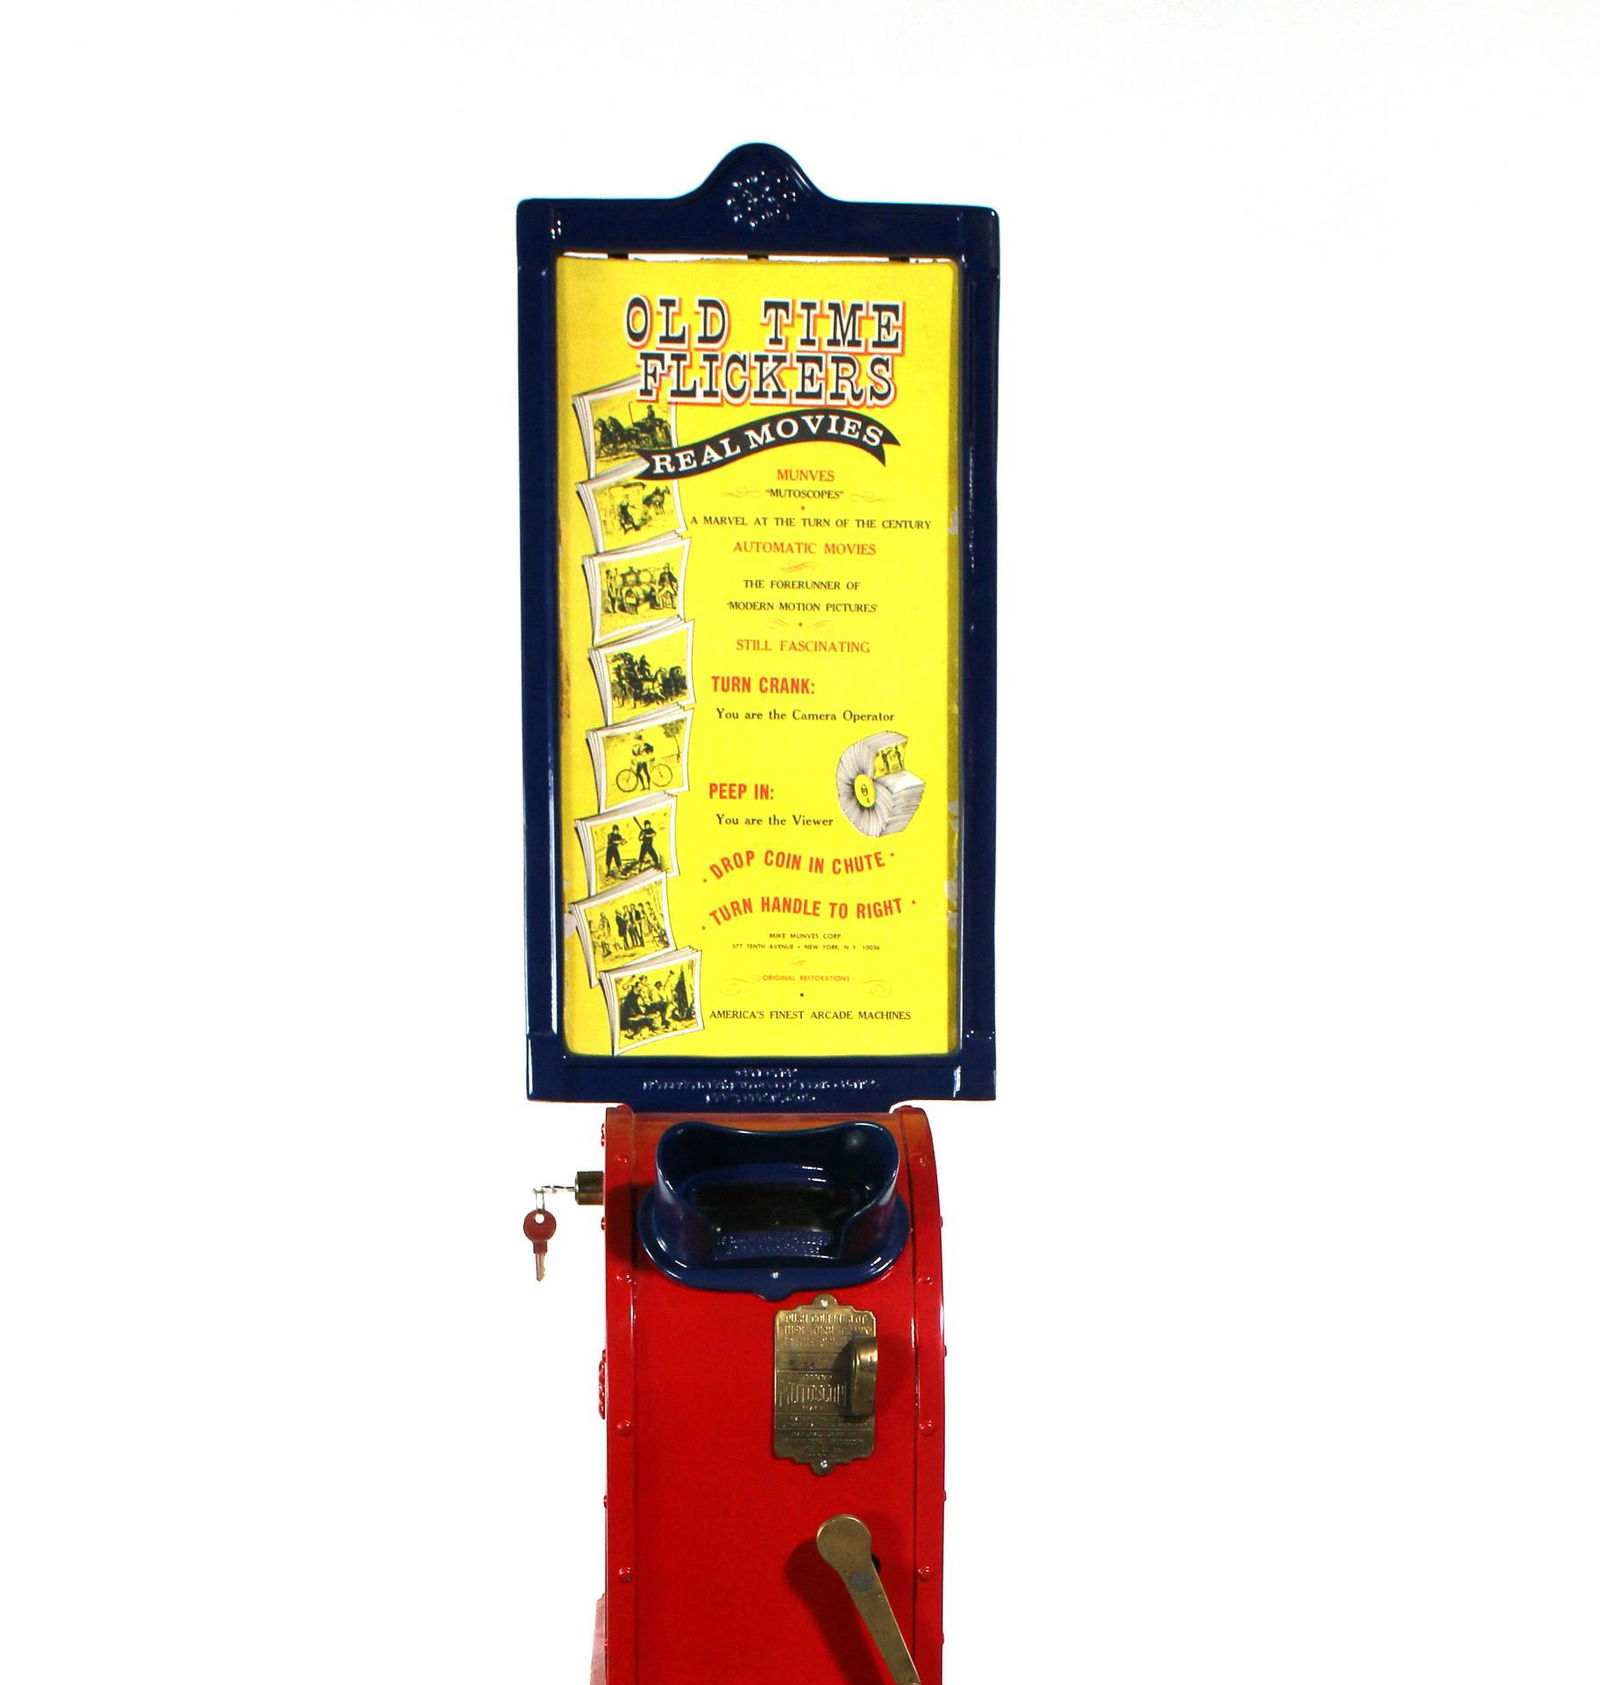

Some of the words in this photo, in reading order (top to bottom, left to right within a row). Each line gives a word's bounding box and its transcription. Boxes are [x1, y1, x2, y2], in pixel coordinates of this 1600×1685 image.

[625, 294, 730, 350] OLD
[761, 298, 904, 354] TIME
[637, 352, 898, 407] FLICKERS
[652, 437, 741, 474] REAL
[749, 414, 885, 449] MOVIES
[776, 468, 835, 483] MUNVES
[690, 515, 699, 525] A
[703, 515, 748, 526] MARVEL
[753, 516, 769, 527] AT
[774, 516, 796, 527] THE
[801, 517, 831, 528] TURN
[834, 518, 850, 528] OF
[854, 518, 877, 529] THE
[881, 519, 932, 530] CENTURY
[733, 540, 817, 555] AUTOMATIC
[824, 542, 877, 556] MOVIES
[743, 579, 765, 589] THE
[770, 579, 841, 591] FORERUNNER
[845, 581, 861, 591] OF
[779, 601, 821, 612] MOTION
[735, 638, 773, 652] STILL
[779, 639, 871, 654] FASCINATING
[710, 675, 752, 693] TURN
[758, 676, 815, 695] CRANK:
[715, 707, 740, 720] You
[744, 712, 764, 720] are
[768, 708, 787, 721] the
[791, 708, 837, 721] Camera
[842, 709, 895, 724] Operator
[708, 782, 748, 800] PEEP
[754, 783, 774, 801] IN:
[715, 813, 739, 826] You
[744, 817, 763, 826] are
[768, 813, 787, 826] the
[791, 814, 834, 827] Viewer
[708, 849, 756, 880] DROP
[763, 849, 802, 871] COIN
[808, 856, 825, 874] IN
[831, 850, 886, 876] CHUTE
[708, 897, 754, 926] TURN
[760, 895, 822, 917] HANDLE
[828, 901, 849, 920] TO
[856, 897, 902, 920] RIGHT
[789, 932, 820, 940] MUNVES
[761, 974, 796, 982] ORIGINAL
[799, 974, 851, 982] RESTORATIONS
[709, 1009, 765, 1020] AMERICA'S
[769, 1010, 805, 1020] FINEST
[810, 1010, 853, 1020] ARCADE
[858, 1010, 912, 1021] MACHINES
